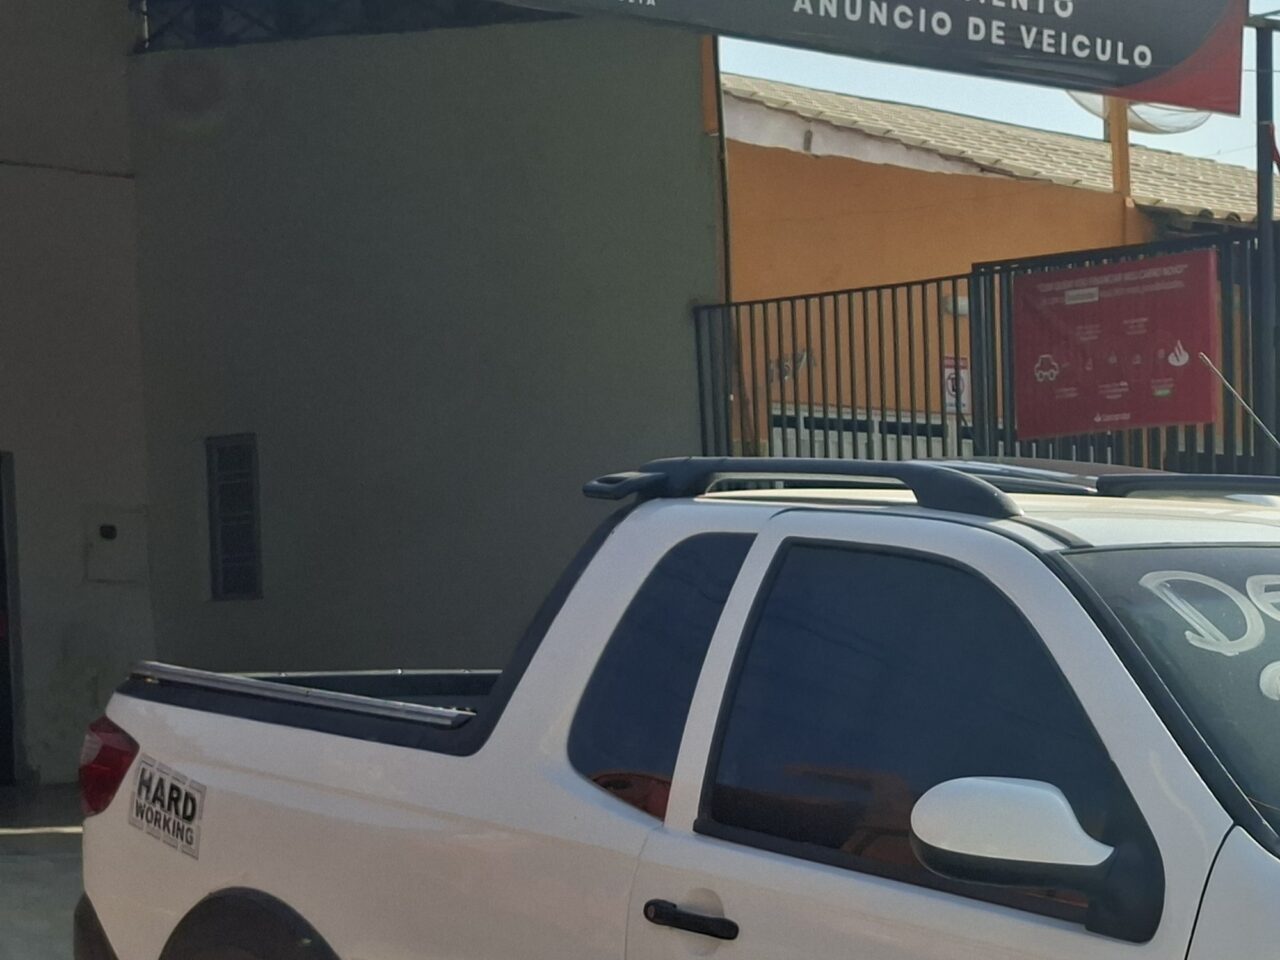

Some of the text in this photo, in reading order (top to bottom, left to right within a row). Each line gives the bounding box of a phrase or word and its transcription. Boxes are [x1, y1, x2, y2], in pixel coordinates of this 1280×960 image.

[793, 0, 1152, 67] ANUNCIO DE VEICULO
[134, 799, 194, 846] WORKING
[138, 767, 197, 823] HARD
